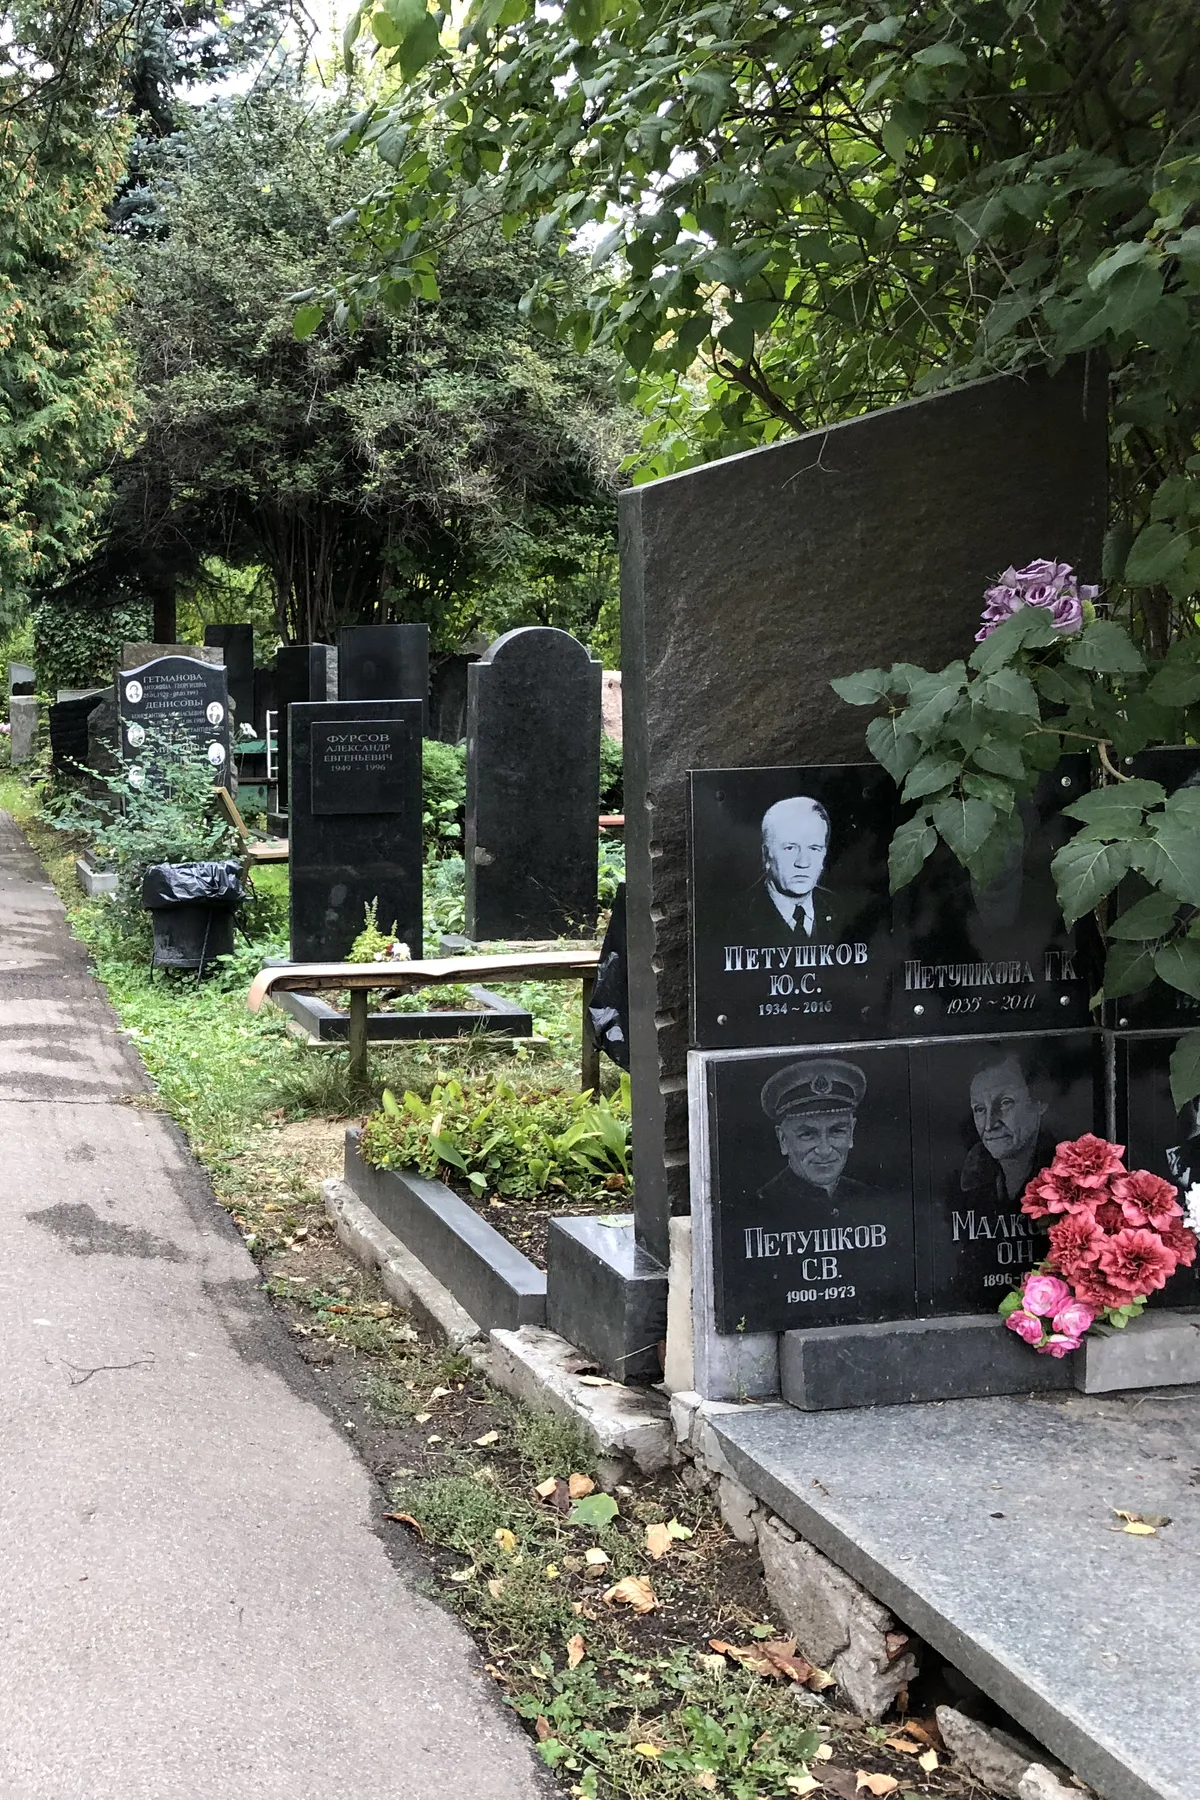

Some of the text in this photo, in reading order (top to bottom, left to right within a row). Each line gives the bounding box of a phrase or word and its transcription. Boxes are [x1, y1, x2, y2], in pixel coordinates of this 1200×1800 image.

[143, 674, 203, 683] ГЕТМАНОВА
[145, 699, 203, 709] ДЕНИСОВЫ
[326, 744, 391, 752] АЛЕКСАНДР
[327, 734, 390, 743] ФУРСОВ
[324, 754, 393, 762] ЕВГЕНЬЕВИЧ
[724, 942, 868, 971] ПЕТУШКОВ
[769, 972, 822, 996] Ю.С.
[904, 960, 1035, 991] ПЕТУШКОВА
[759, 1002, 788, 1016] 1934
[803, 1000, 833, 1013] 2016
[946, 995, 983, 1015] 1935
[1000, 994, 1037, 1012] 2011
[951, 1209, 1048, 1242] МАЛКО
[743, 1223, 887, 1260] ПЕТУШКОВ
[802, 1256, 843, 1281] С.В.
